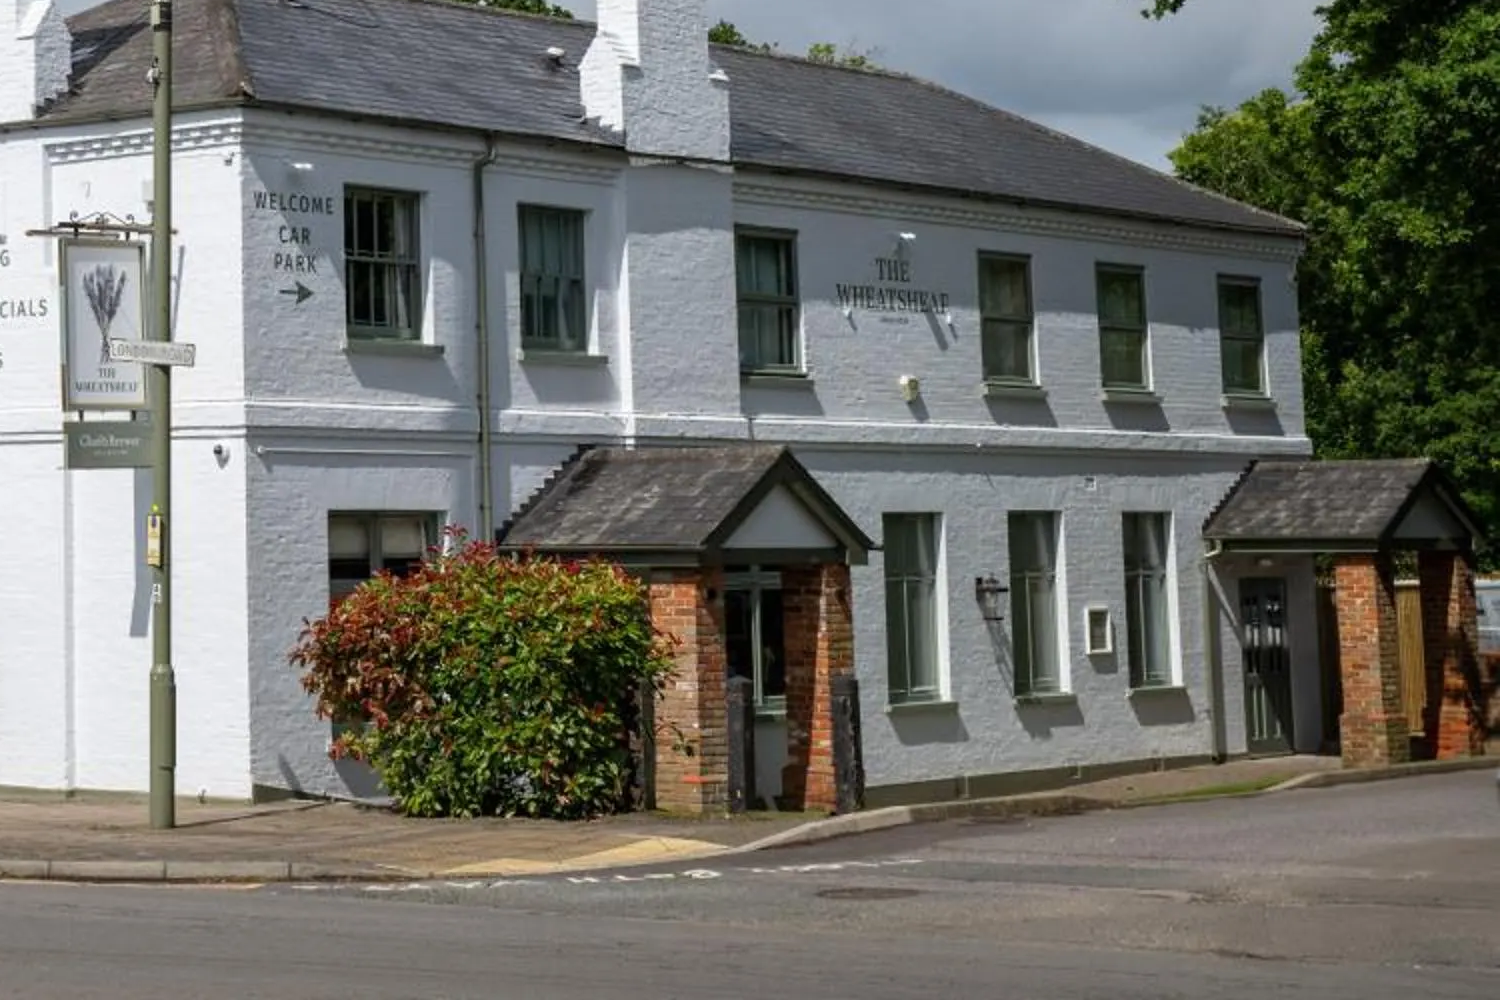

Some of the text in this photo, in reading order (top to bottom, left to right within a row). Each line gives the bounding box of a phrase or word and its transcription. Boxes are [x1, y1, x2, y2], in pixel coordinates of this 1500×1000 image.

[254, 191, 334, 215] WELCOME
[279, 225, 311, 245] CAR
[274, 253, 317, 274] PARK
[875, 258, 910, 282] THE
[836, 283, 949, 314] WHEATSHEAF
